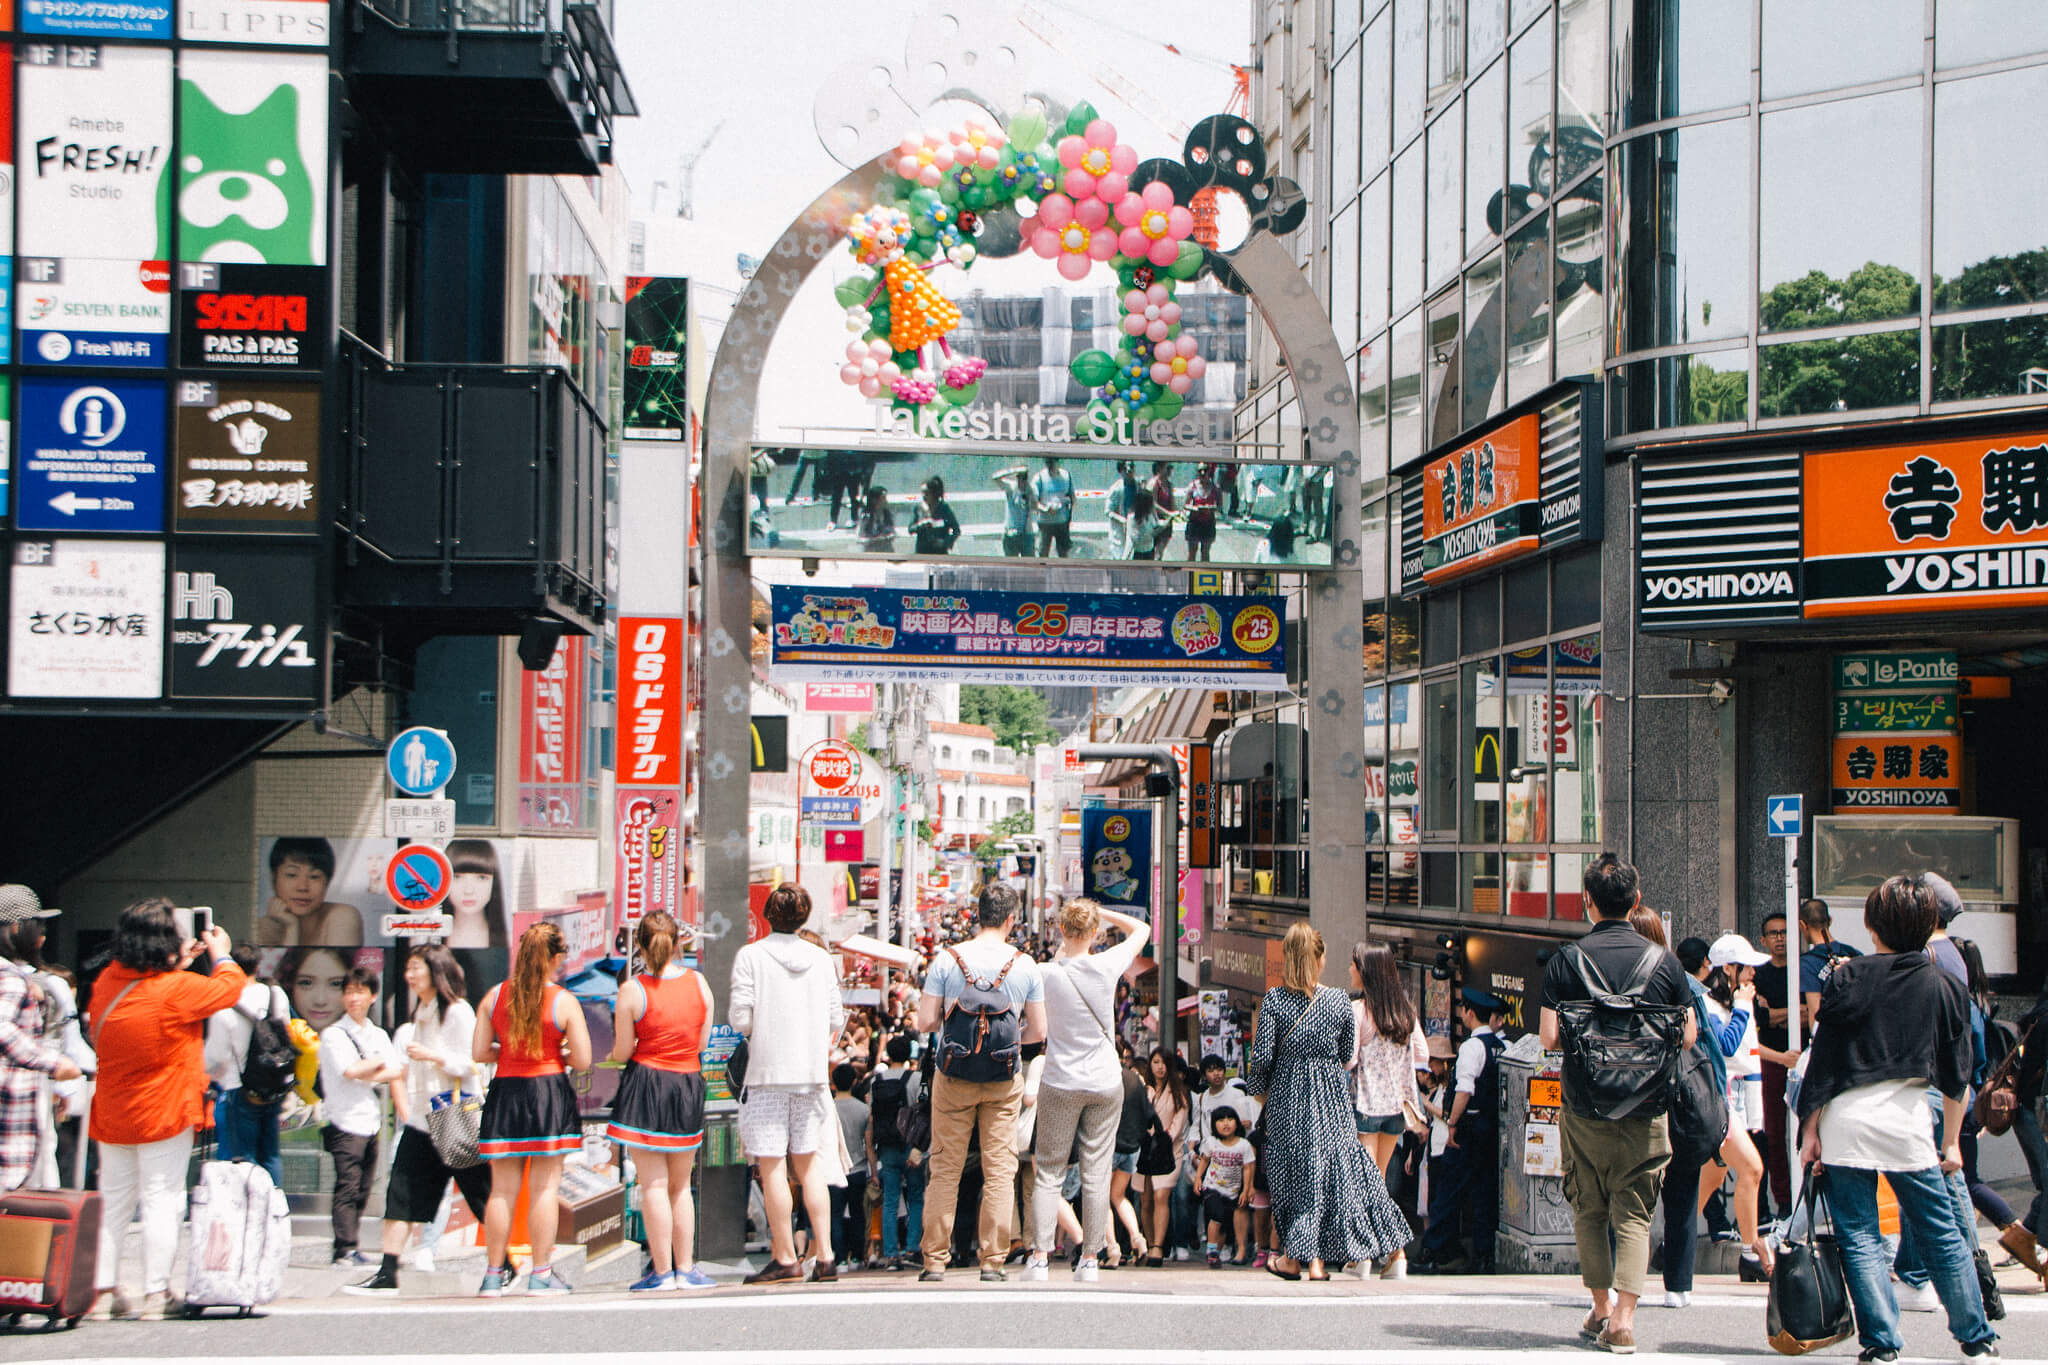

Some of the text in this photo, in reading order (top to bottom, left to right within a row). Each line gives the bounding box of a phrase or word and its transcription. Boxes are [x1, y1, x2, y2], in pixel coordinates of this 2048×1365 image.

[187, 10, 327, 34] LIPPS
[29, 45, 55, 64] 1F
[69, 46, 97, 66] 2F
[69, 116, 125, 133] Ameba
[35, 136, 160, 178] FRESH!
[69, 184, 122, 200] Studio
[25, 261, 55, 281] 1F
[184, 265, 215, 287] 1F
[64, 303, 163, 318] SEVEN BANK
[195, 293, 307, 332] SASAKI
[75, 339, 151, 357] Free Wi-Fi
[204, 335, 244, 353] PAS
[261, 336, 299, 354] PAS
[205, 354, 299, 365] HARAJUKU SASAKI
[181, 381, 212, 402] BF
[871, 399, 1217, 447] Takeshita Street
[27, 460, 156, 473] INFORMATION CENTER
[254, 460, 309, 472] COFFEE
[102, 497, 135, 511] 20m
[180, 477, 315, 511] 星乃珈琲
[1542, 493, 1581, 526] YOSHINOYA
[1443, 518, 1497, 562] YOSHINOYA
[23, 543, 51, 564] BF
[1645, 570, 1794, 601] YOSHINOYA
[28, 610, 149, 637] さくら水産
[1250, 618, 1269, 638] 25
[196, 623, 317, 668] アッシュ
[1185, 631, 1220, 655] 2016
[1898, 657, 1959, 682] Ponte
[1863, 699, 1946, 716] ビリヤード
[1877, 714, 1931, 728] ダーツ
[813, 760, 850, 778] 消火栓
[1846, 744, 1949, 780] 吉野家
[1846, 789, 1949, 806] YOSHINOYA
[665, 827, 677, 916] ENTERTAINMEN
[653, 861, 662, 904] STUDIO
[1490, 973, 1525, 992] WOLFGANG
